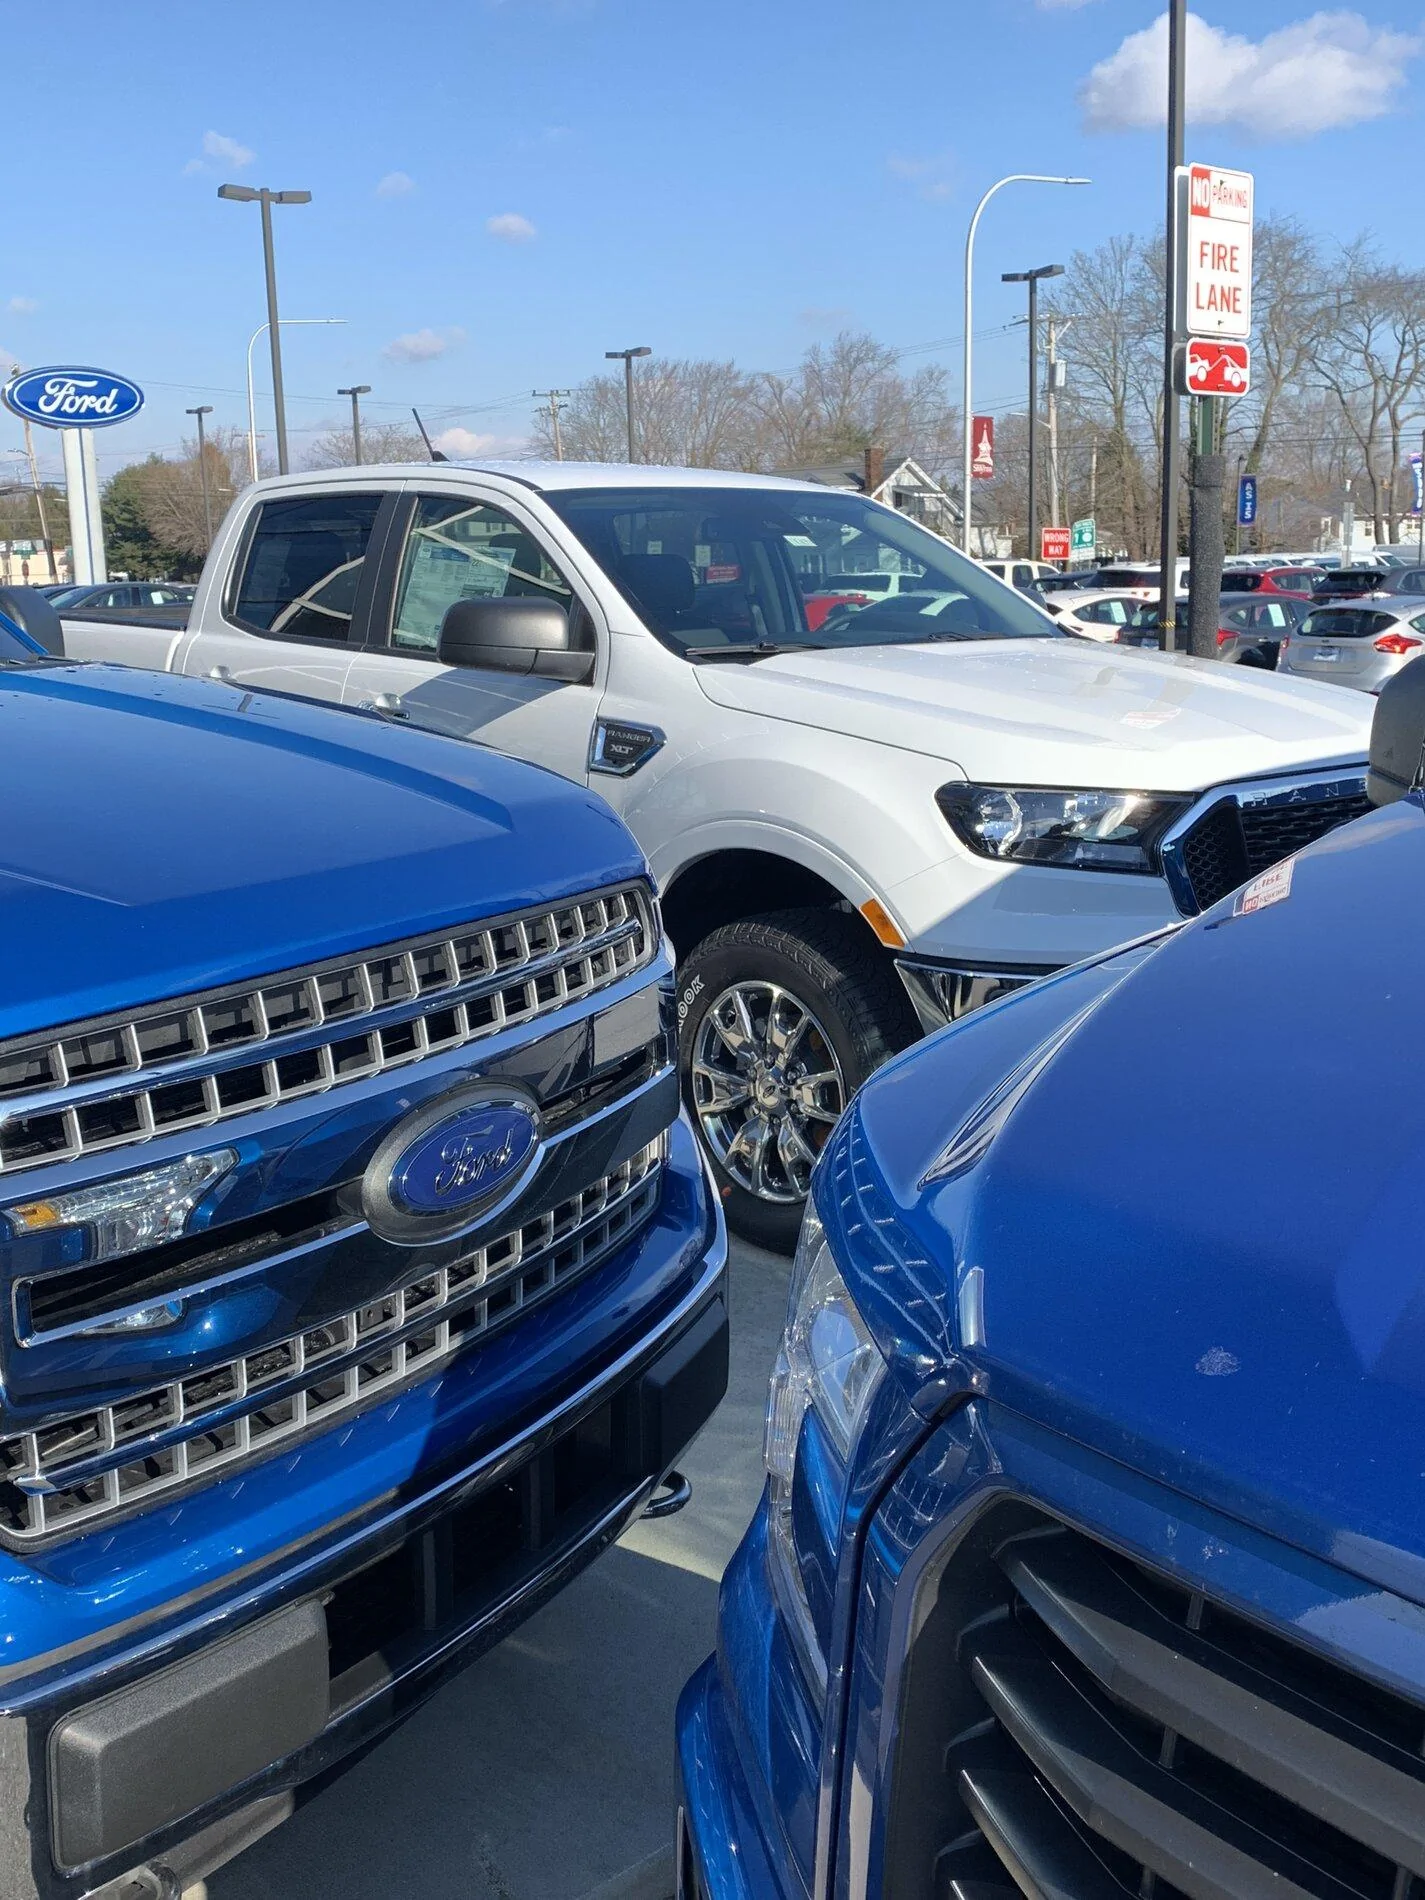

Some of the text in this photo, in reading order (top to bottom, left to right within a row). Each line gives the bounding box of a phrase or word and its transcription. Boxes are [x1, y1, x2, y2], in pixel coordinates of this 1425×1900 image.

[1192, 176, 1248, 209] NO PARKING
[1199, 241, 1240, 273] FIRE
[1195, 282, 1242, 314] LANE
[38, 377, 119, 414] Ford
[1244, 482, 1253, 519] AS IS
[1044, 532, 1069, 543] WRONG
[1048, 545, 1064, 555] WAY
[607, 730, 650, 742] RANGER
[610, 744, 633, 755] XLT
[435, 1125, 514, 1195] Ford
